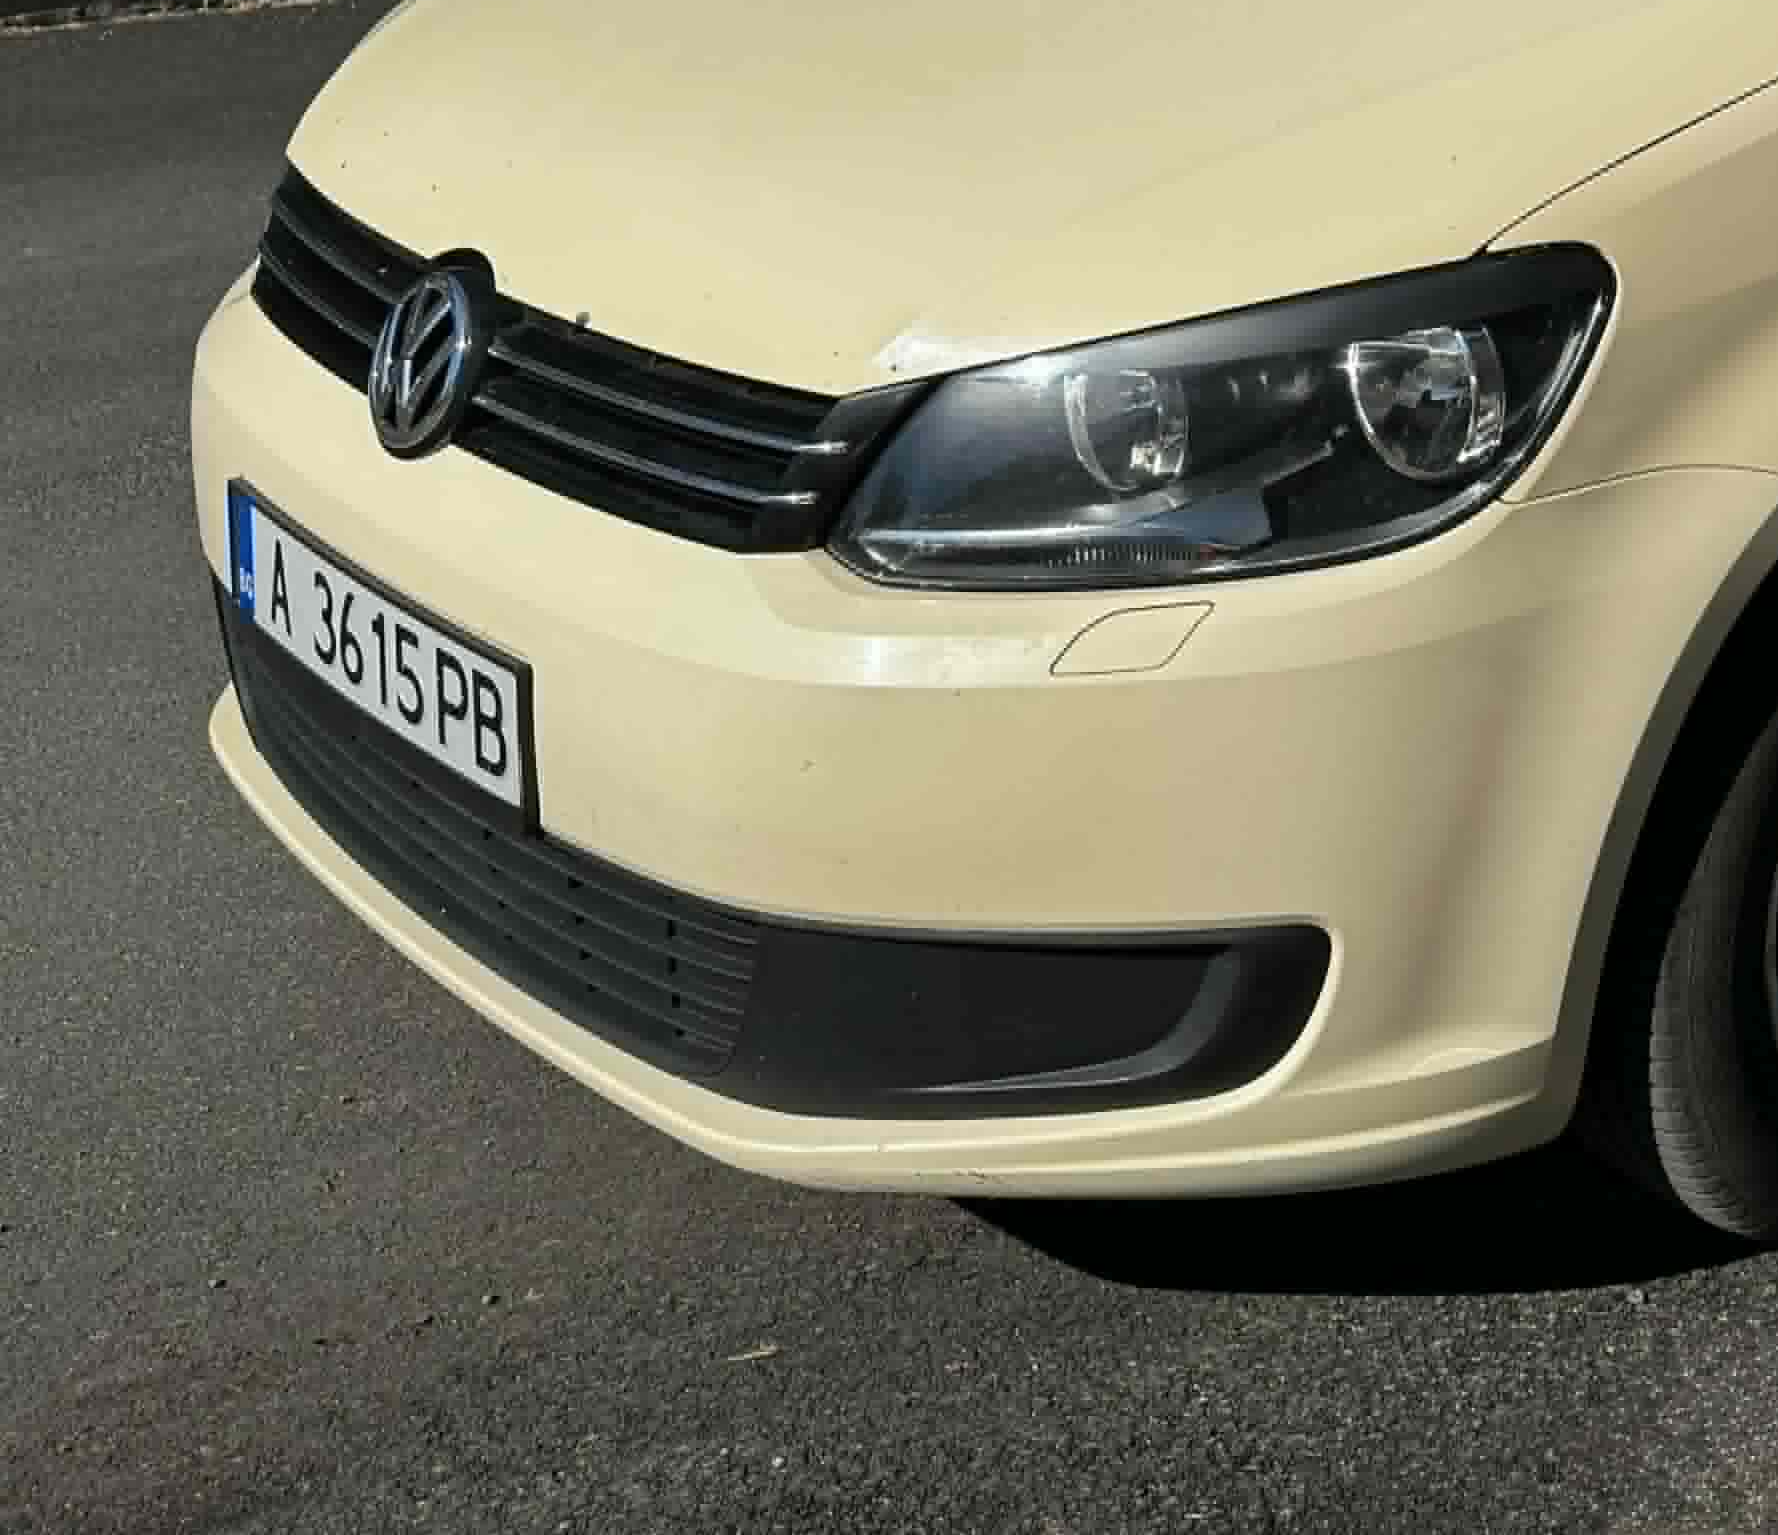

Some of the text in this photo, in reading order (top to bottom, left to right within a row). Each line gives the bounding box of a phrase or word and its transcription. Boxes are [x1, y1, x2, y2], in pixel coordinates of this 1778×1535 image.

[370, 272, 466, 446] VW
[271, 538, 292, 636] A
[313, 571, 424, 724] 3615
